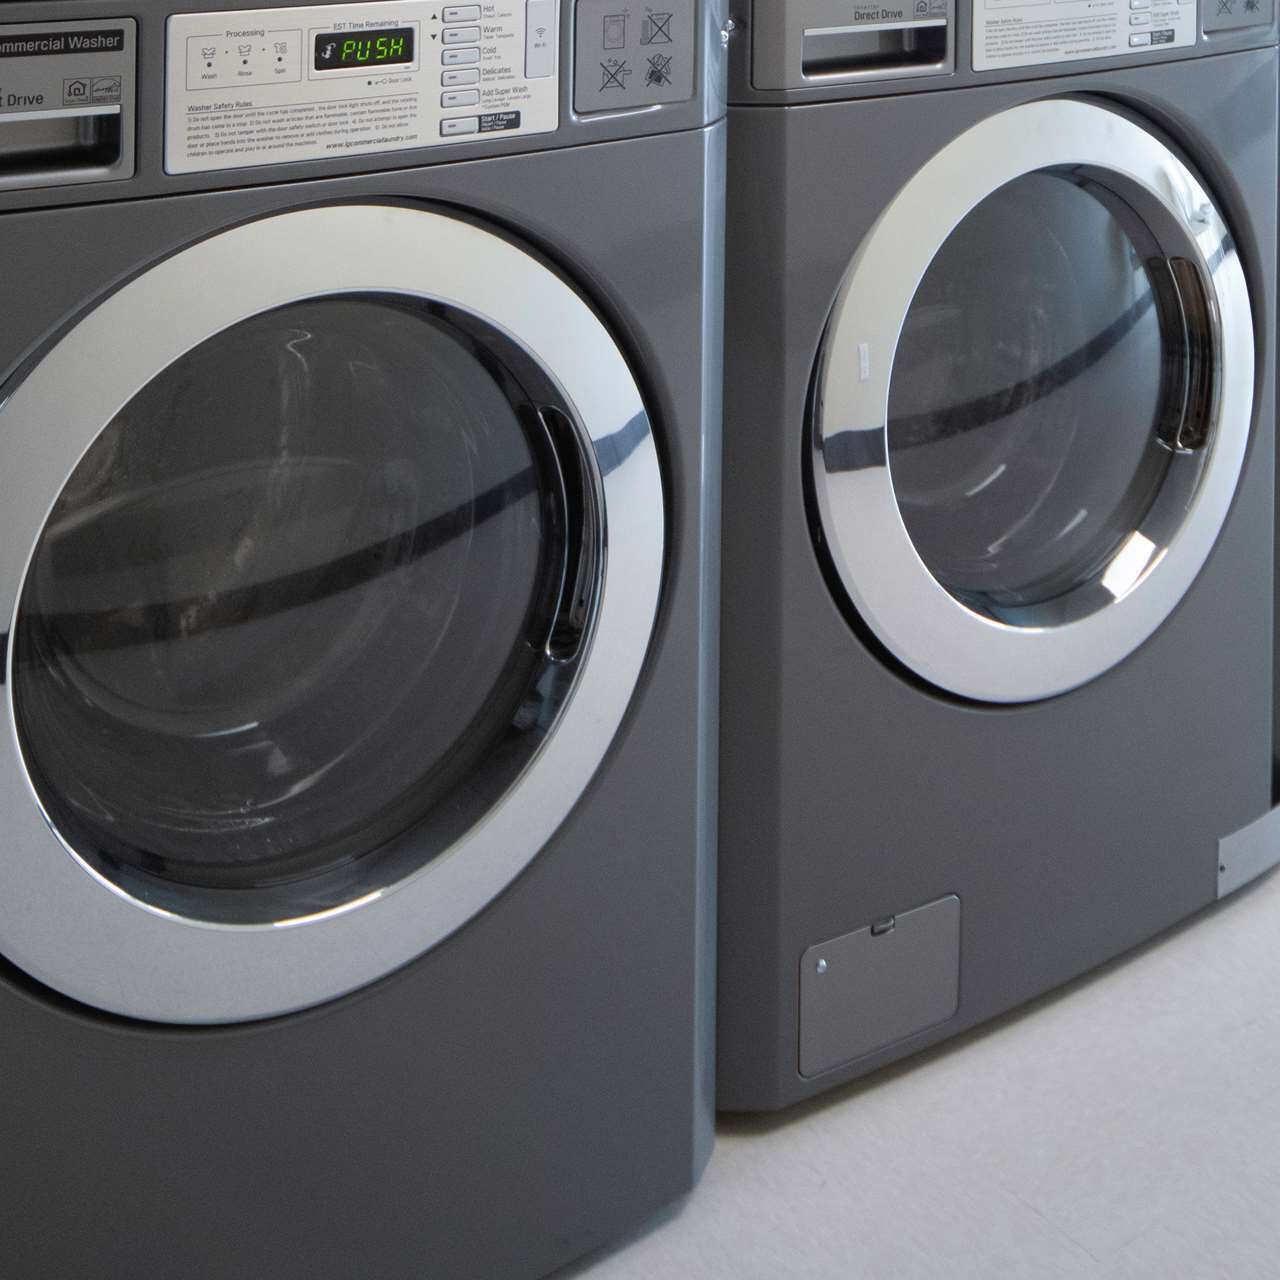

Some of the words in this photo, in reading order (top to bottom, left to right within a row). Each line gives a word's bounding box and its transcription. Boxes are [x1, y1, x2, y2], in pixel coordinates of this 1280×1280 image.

[483, 5, 495, 13] Hot
[854, 9, 879, 21] Direct
[881, 8, 903, 18] Drive
[348, 22, 364, 30] Time
[365, 19, 399, 29] Remaining
[483, 25, 503, 33] Warm
[225, 29, 265, 39] Processing
[68, 35, 120, 50] Washer
[341, 36, 404, 62] PUSH
[482, 46, 497, 54] Cold
[482, 67, 512, 76] Delicates
[7, 93, 44, 107] Drive
[187, 103, 212, 112] Washer
[213, 103, 234, 111] Safety
[481, 114, 495, 122] Start
